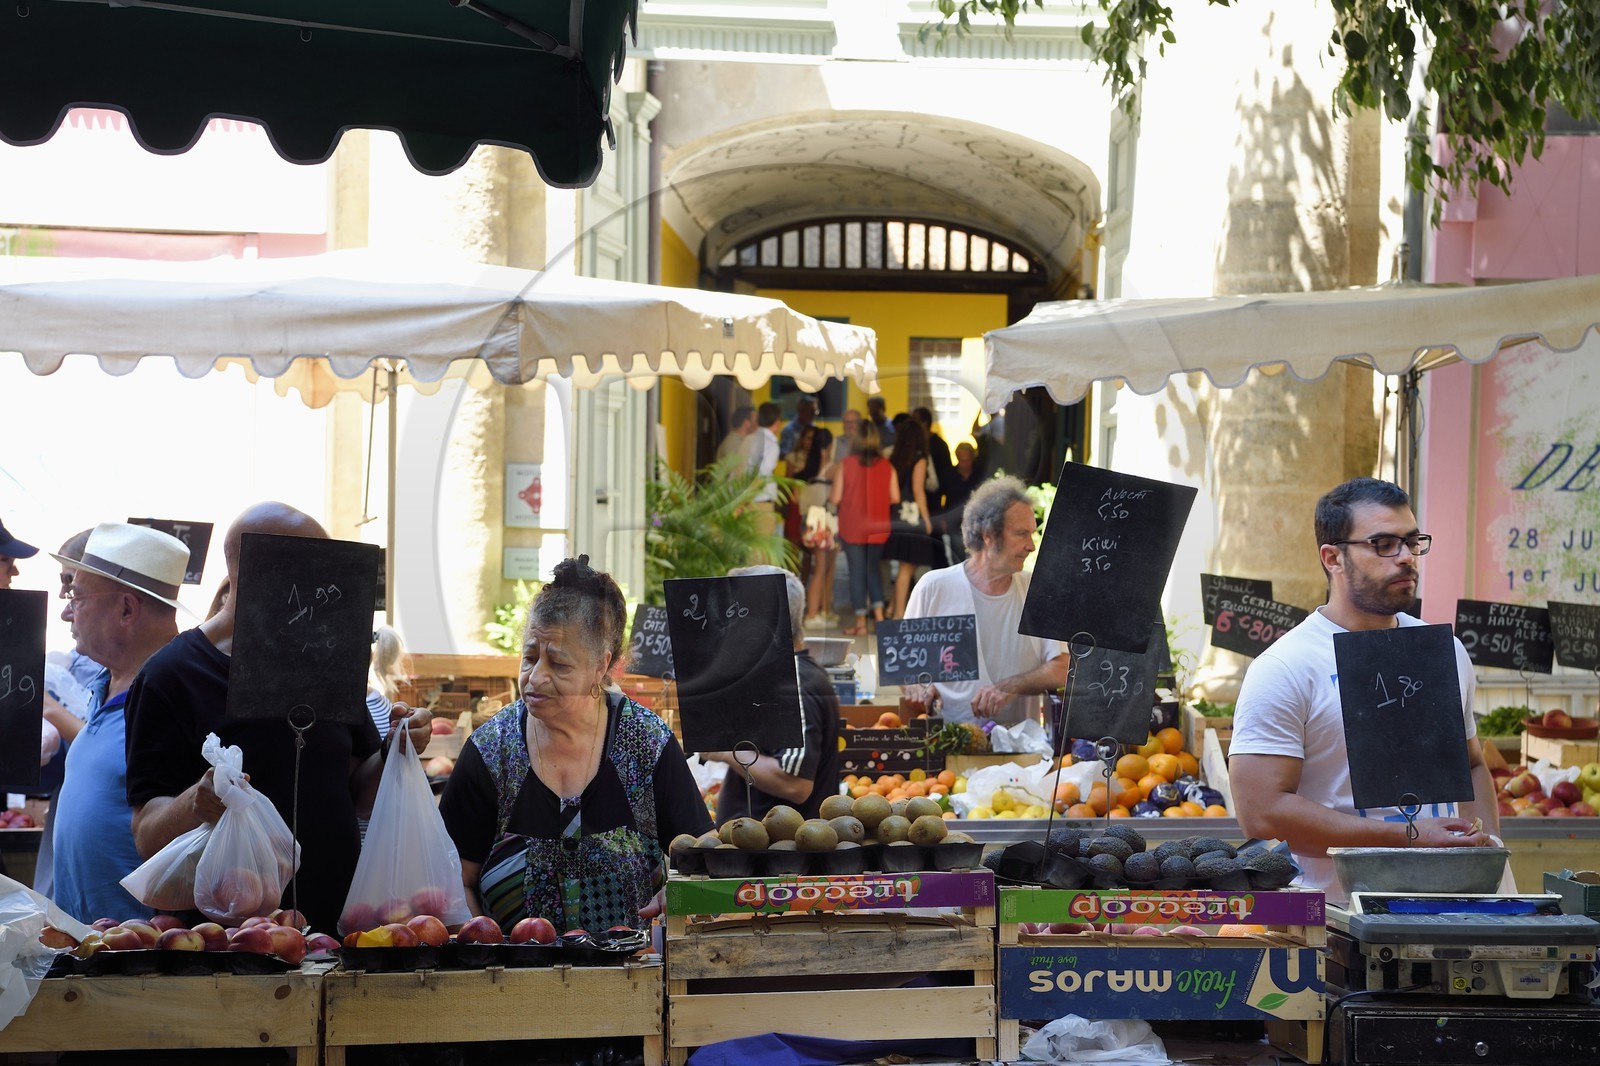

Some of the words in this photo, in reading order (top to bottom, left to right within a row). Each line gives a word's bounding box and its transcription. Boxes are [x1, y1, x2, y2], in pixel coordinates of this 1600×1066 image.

[1100, 487, 1153, 501] AVOCAT
[1508, 527, 1538, 549] 28
[1562, 529, 1593, 550] JU
[1081, 554, 1111, 573] 3,50
[1507, 569, 1551, 590] 1er
[287, 583, 342, 625] 1,99
[646, 607, 668, 619] PEC
[1241, 595, 1293, 615] CERISES
[1489, 603, 1527, 618] FUJI
[898, 616, 975, 633] ABRICOTS
[902, 632, 962, 644] PROVENCE
[1375, 671, 1424, 709] 1,80
[853, 734, 879, 743] Fruits
[738, 880, 919, 902] trecoop
[1073, 896, 1253, 915] trecoop
[1031, 955, 1054, 969] fruit
[1057, 955, 1078, 968] love
